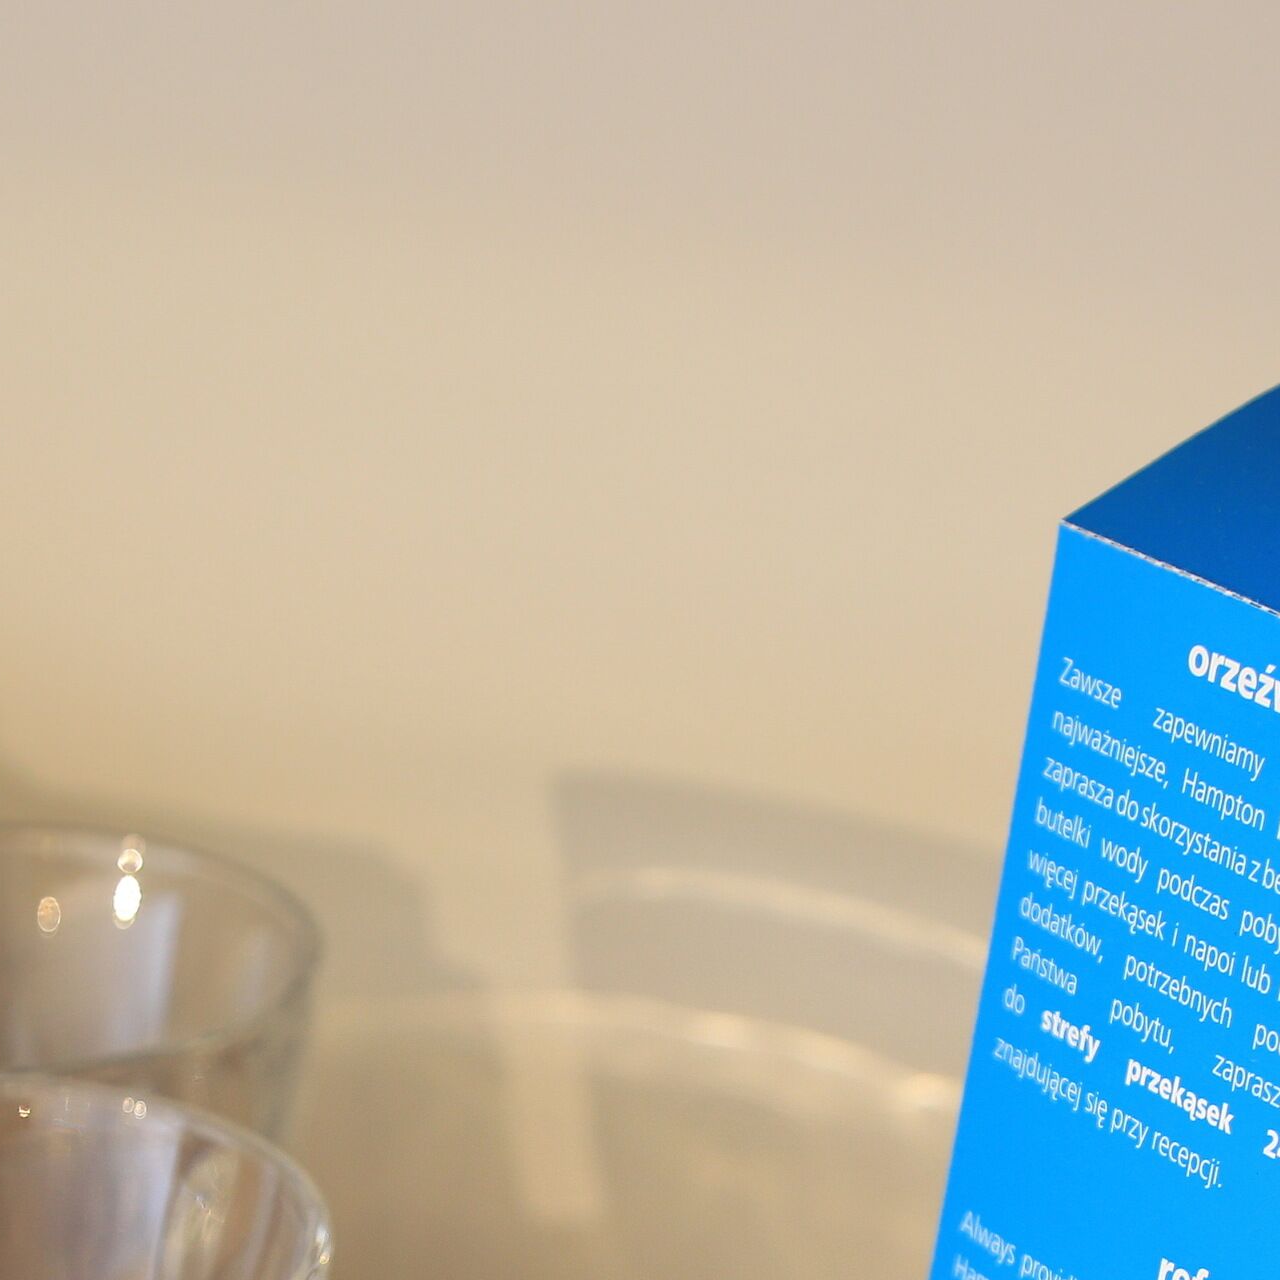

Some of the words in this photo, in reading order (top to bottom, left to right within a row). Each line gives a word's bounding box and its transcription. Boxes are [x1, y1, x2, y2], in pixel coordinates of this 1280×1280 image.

[1052, 710, 1169, 790] najważniejsze,
[1181, 767, 1266, 831] Hampton
[1058, 656, 1122, 709] Zawsze
[1152, 707, 1266, 782] zapewniamy
[1034, 796, 1091, 849] butelki
[1101, 837, 1149, 884] wody
[1156, 867, 1231, 921] podczas
[1042, 756, 1115, 810] zaprasza
[1115, 789, 1140, 822] do
[1140, 803, 1248, 876] skorzystania
[1247, 859, 1262, 883] z
[1020, 892, 1104, 964] dodatków,
[1123, 954, 1233, 1028] potrzebnych
[1028, 850, 1078, 901] więcej
[1081, 880, 1167, 941] przekąsek
[1171, 922, 1180, 947] i
[1183, 934, 1236, 977] napoi
[1241, 955, 1272, 995] lub
[1011, 935, 1078, 996] Państwa
[1109, 998, 1175, 1055] pobytu,
[993, 1037, 1082, 1112] znajdującej
[1084, 1092, 1108, 1129] się
[1110, 1107, 1150, 1149] przy
[1151, 1131, 1222, 1189] recepcji.
[1003, 983, 1026, 1015] do
[1040, 1009, 1101, 1064] strefy
[1124, 1058, 1235, 1135] przekąsek
[959, 1210, 1017, 1265] Always
